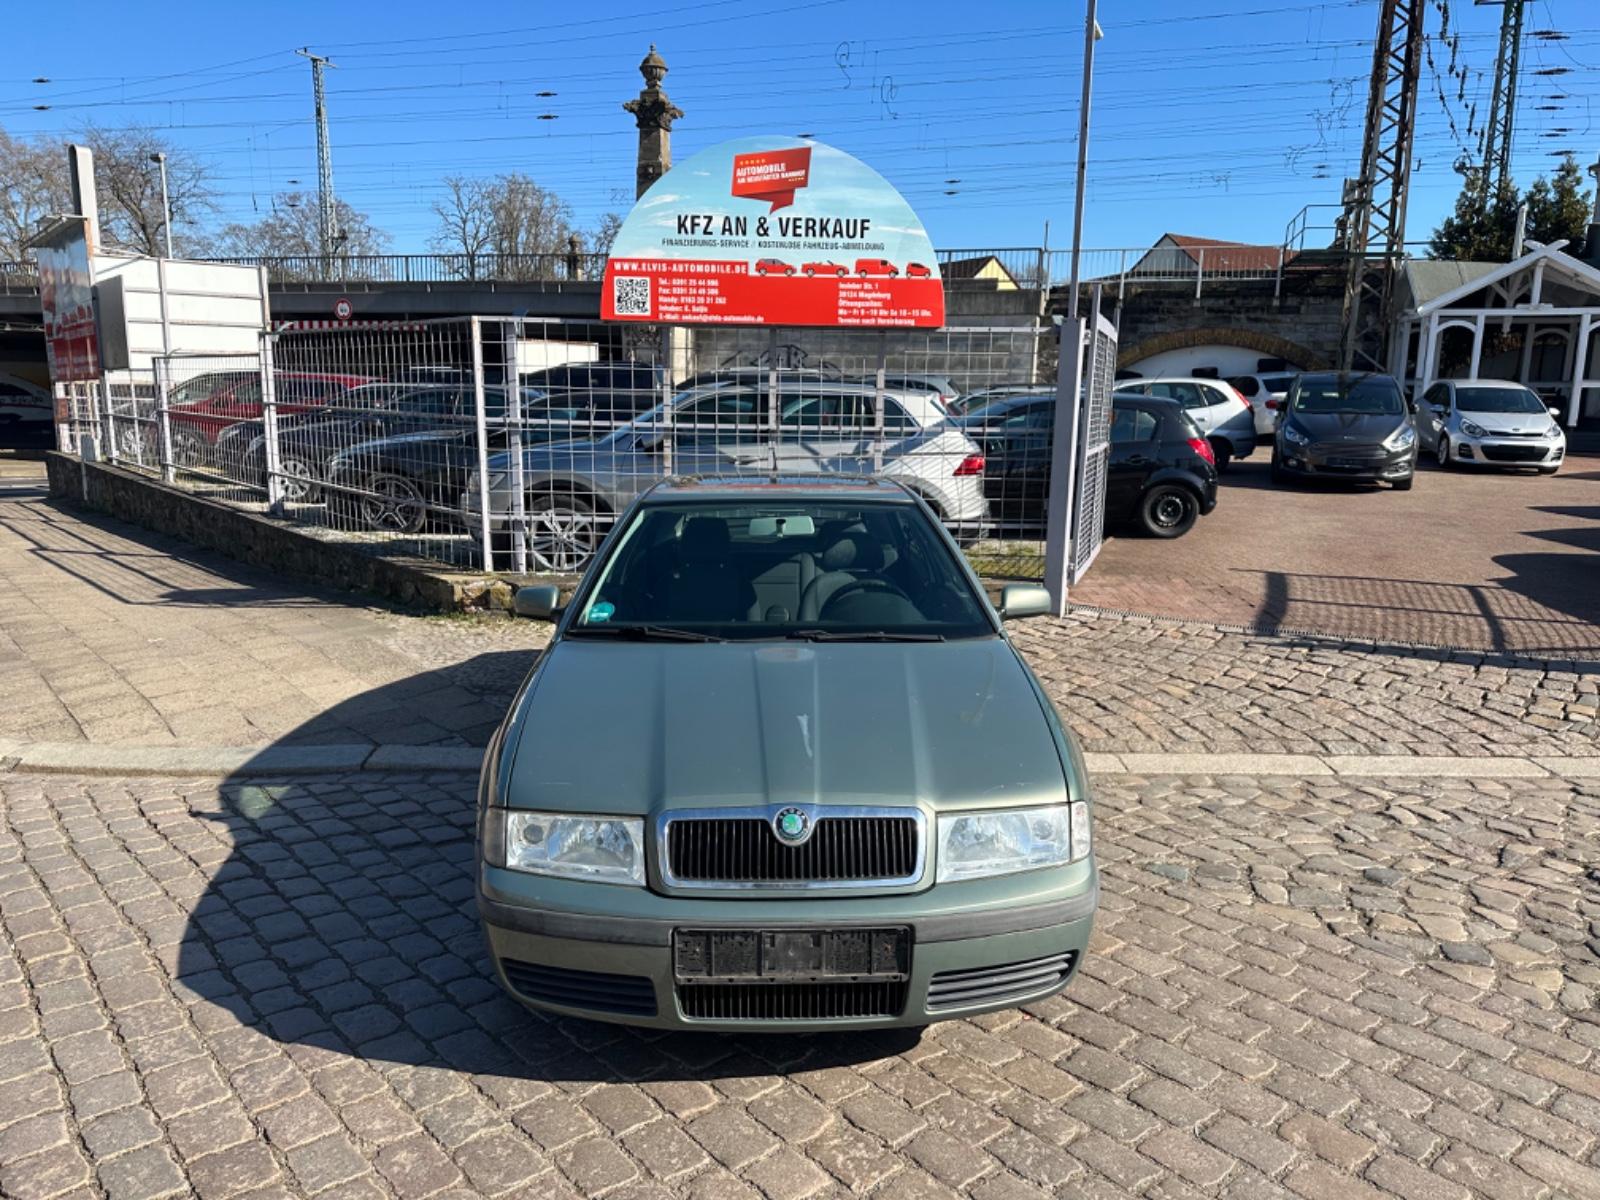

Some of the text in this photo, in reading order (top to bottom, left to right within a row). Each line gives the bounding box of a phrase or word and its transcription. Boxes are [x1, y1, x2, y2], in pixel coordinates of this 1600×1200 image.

[736, 163, 786, 177] AUTOMOBILE
[677, 214, 871, 239] KFZ AN & VERKAUF
[661, 238, 749, 249] FINANZIERUNGS-SERVICE
[758, 240, 801, 250] KOSTENLOSE
[803, 240, 885, 252] FAHRZEUG-ABMELDUNG
[614, 261, 747, 274] WWW.ELVIS-AUTOMOBILE.DE
